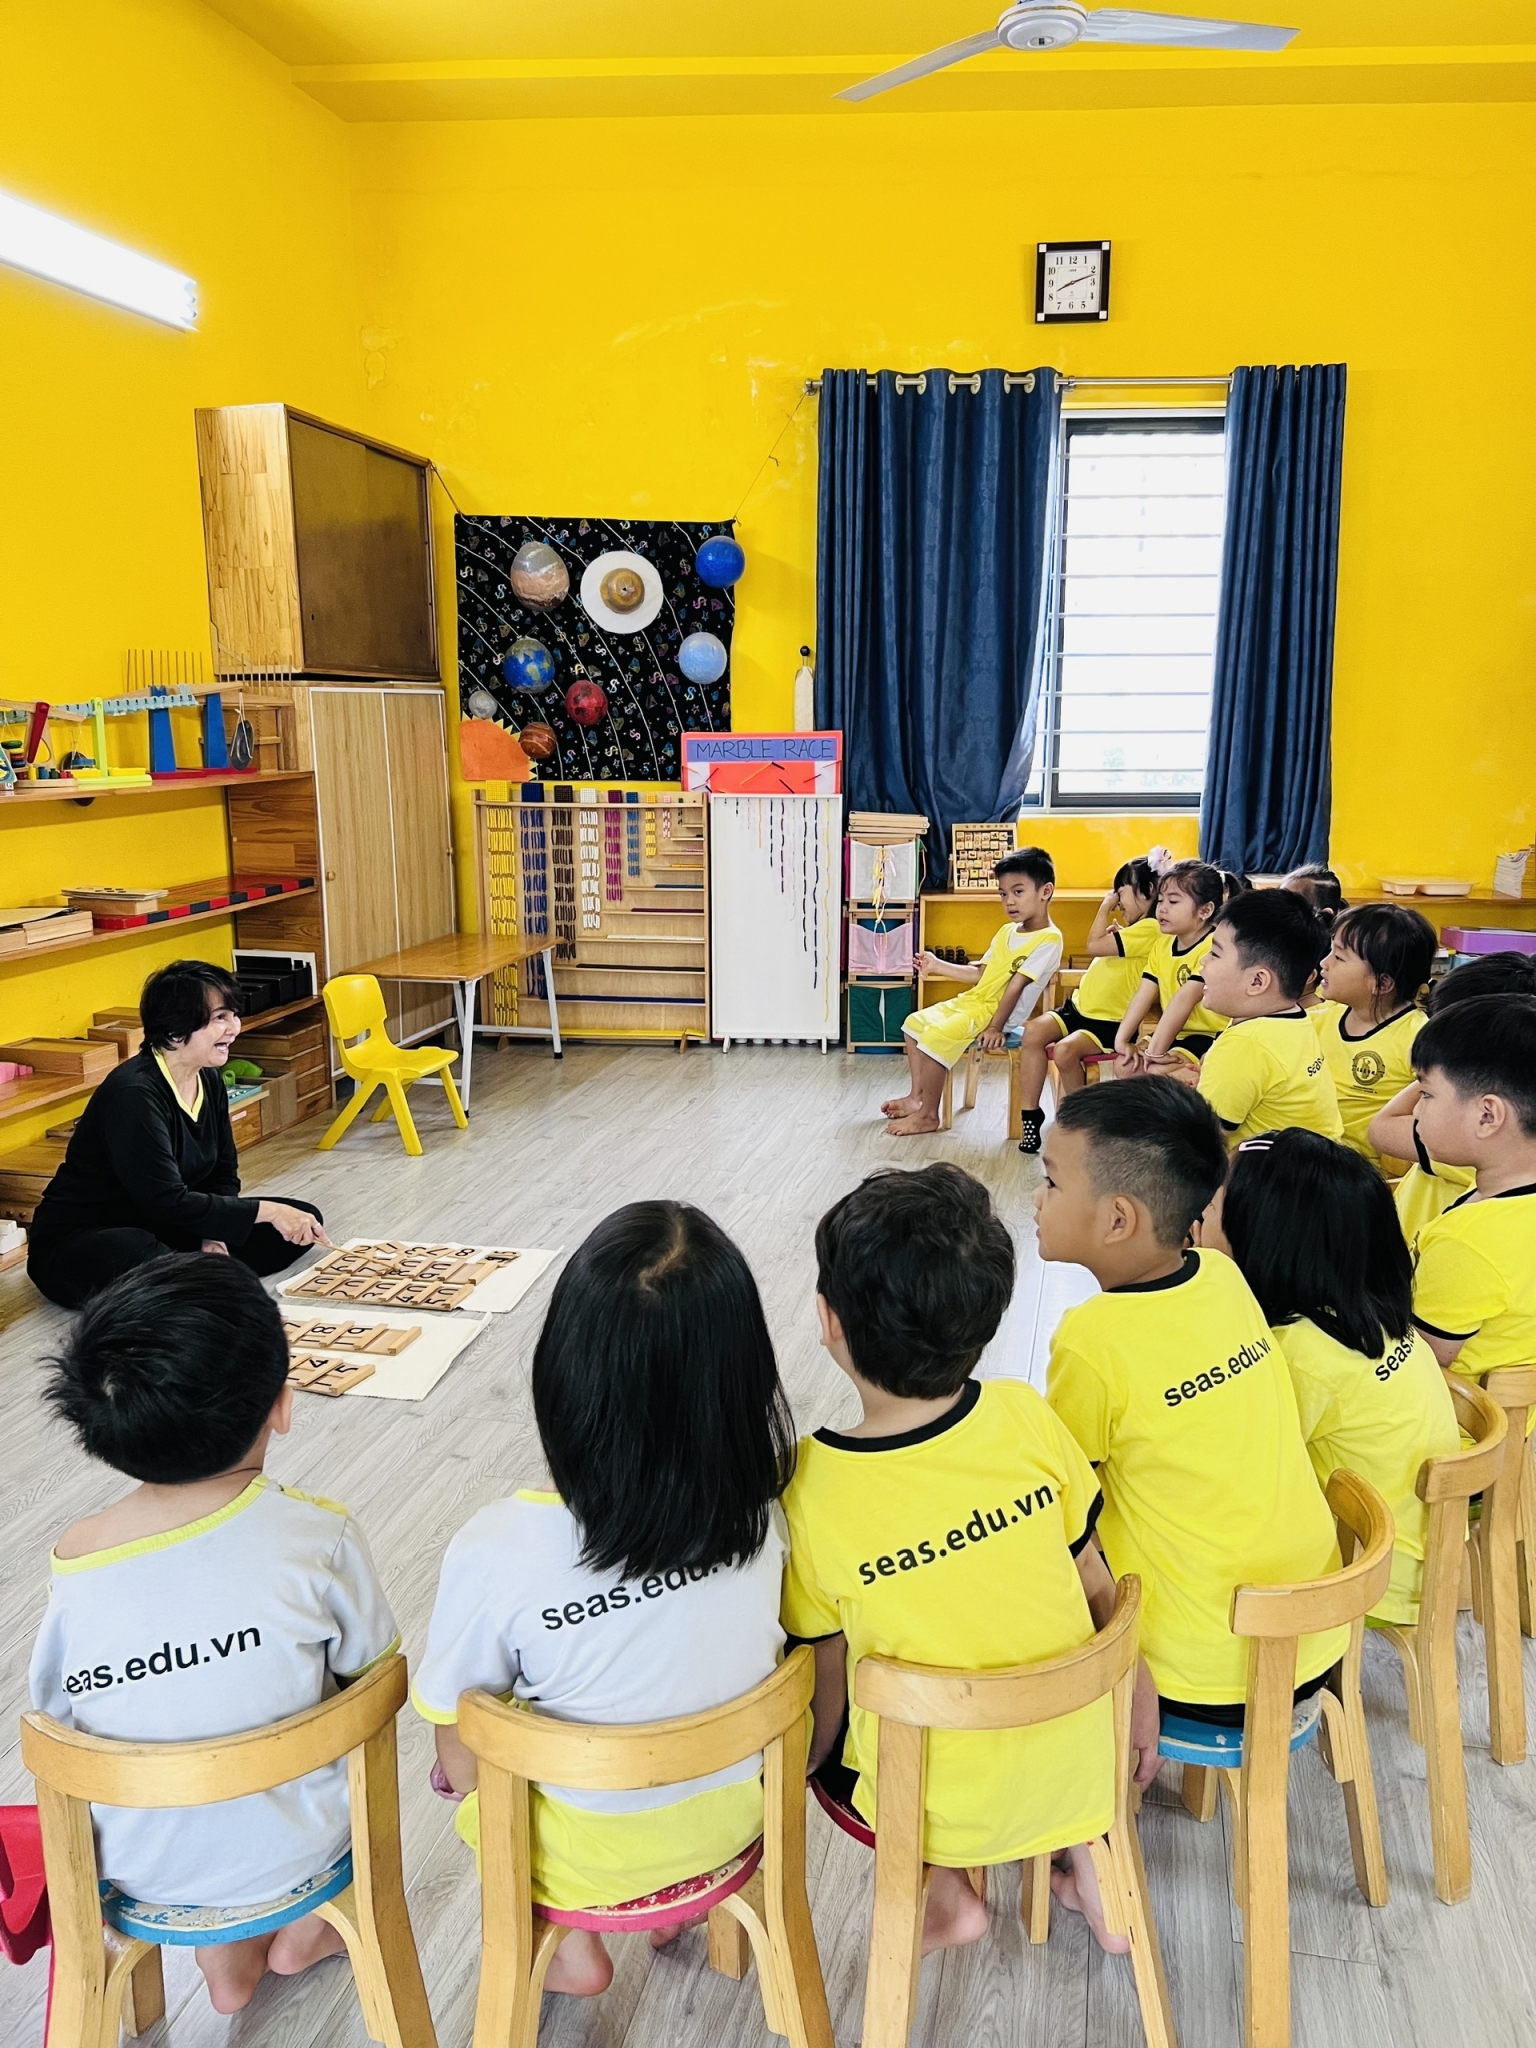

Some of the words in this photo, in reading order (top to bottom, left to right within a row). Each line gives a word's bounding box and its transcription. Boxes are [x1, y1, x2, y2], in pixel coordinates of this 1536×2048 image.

[1056, 256, 1063, 265] 11
[1069, 255, 1078, 265] 12
[1048, 266, 1056, 275] 10
[1090, 265, 1096, 274] 2
[1048, 280, 1054, 288] 9
[1090, 278, 1096, 286] 3
[1048, 293, 1054, 301] 8
[1057, 301, 1062, 310] 7
[1069, 301, 1074, 309] 6
[1080, 300, 1086, 309] 5
[696, 739, 774, 759] MARBLE
[783, 739, 835, 759] RACE
[1306, 1057, 1325, 1077] sea
[353, 1245, 372, 1255] 2
[455, 1247, 476, 1258] 8
[419, 1262, 452, 1279] 90
[301, 1277, 335, 1293] 10
[362, 1282, 397, 1299] 30
[396, 1285, 428, 1303] 40
[425, 1288, 459, 1305] 50
[858, 1485, 1055, 1586] seas.edu.vn
[541, 1553, 735, 1630] seas.edu.
[63, 1626, 262, 1693] eas.edu.vn
